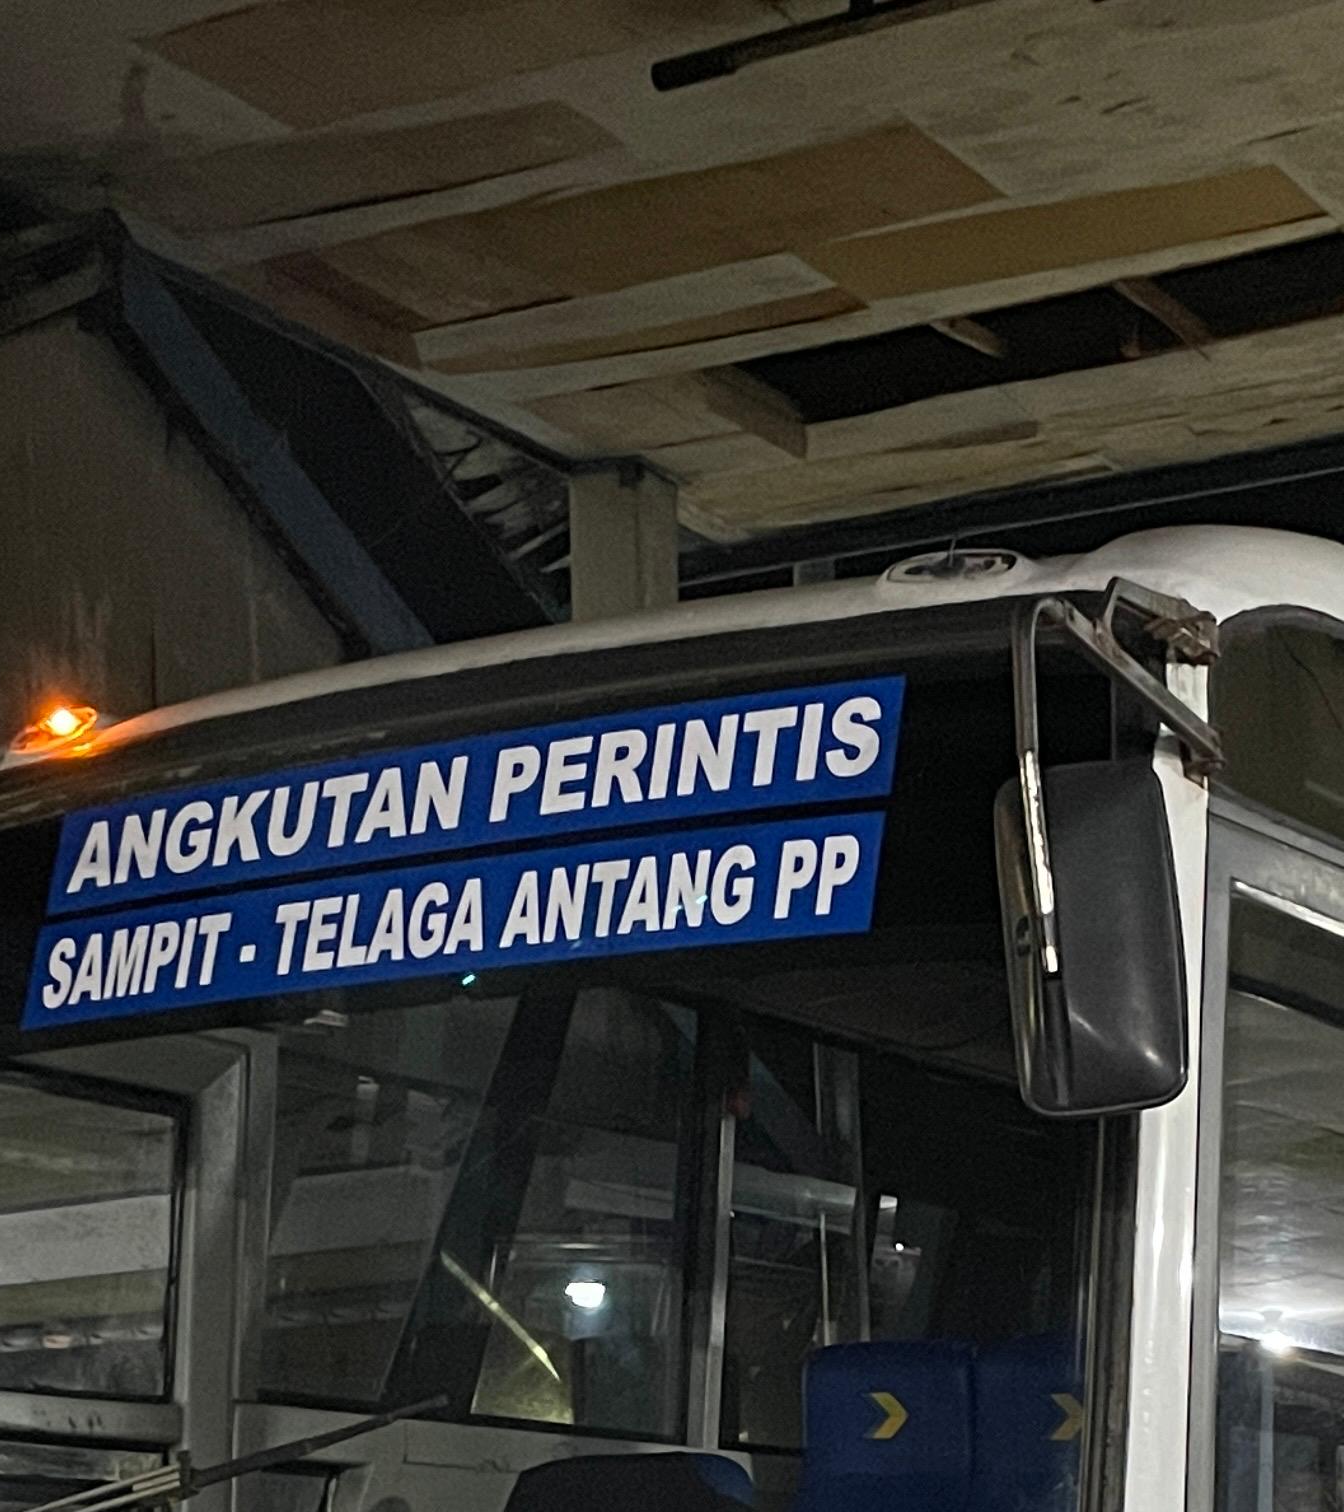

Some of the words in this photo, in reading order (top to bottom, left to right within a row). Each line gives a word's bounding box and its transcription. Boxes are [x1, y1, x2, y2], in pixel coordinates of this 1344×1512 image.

[66, 756, 469, 895] ANGKUTAN
[489, 695, 883, 823] PERINTIS
[41, 912, 234, 1010] SAMPIT
[274, 879, 486, 976] TELAGA
[499, 839, 756, 948] ANTANG
[773, 834, 861, 920] PP
